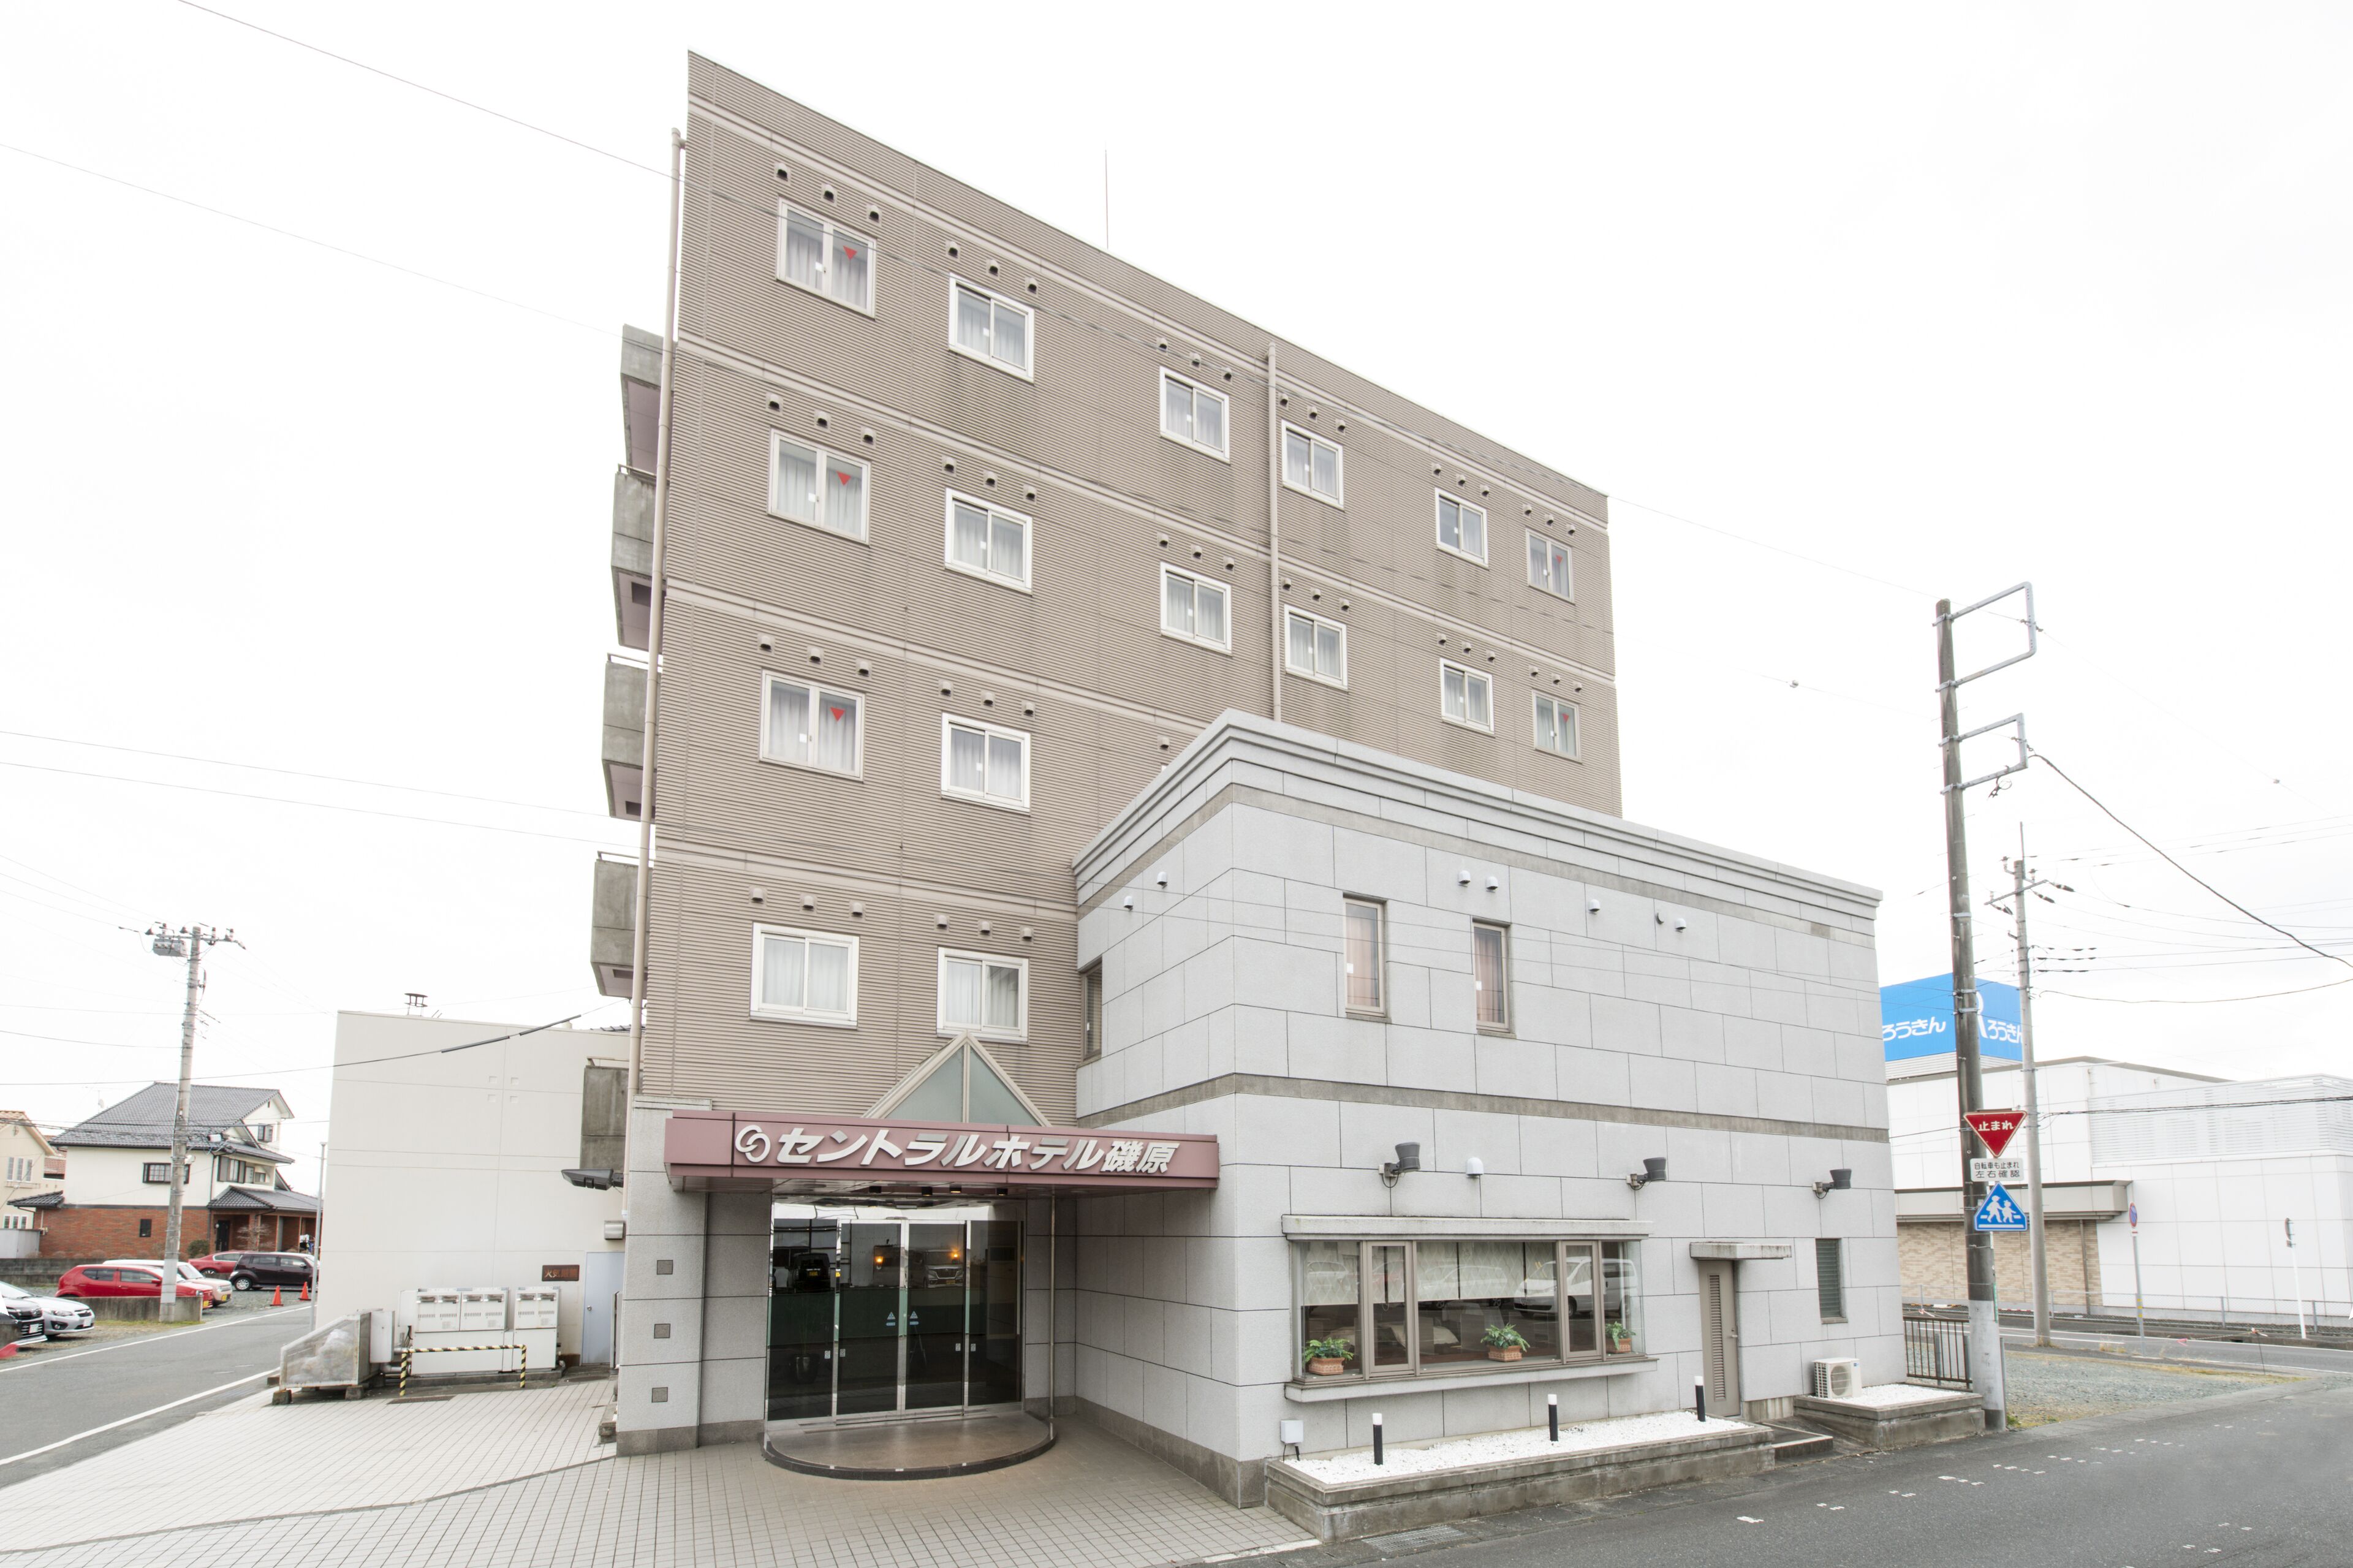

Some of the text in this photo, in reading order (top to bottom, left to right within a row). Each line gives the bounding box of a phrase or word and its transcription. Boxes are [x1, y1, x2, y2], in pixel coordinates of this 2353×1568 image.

[1882, 1017, 1946, 1042] ろうきん
[1978, 1120, 2014, 1131] 止まれ
[776, 1127, 1180, 1174] セントラルホテル磯原
